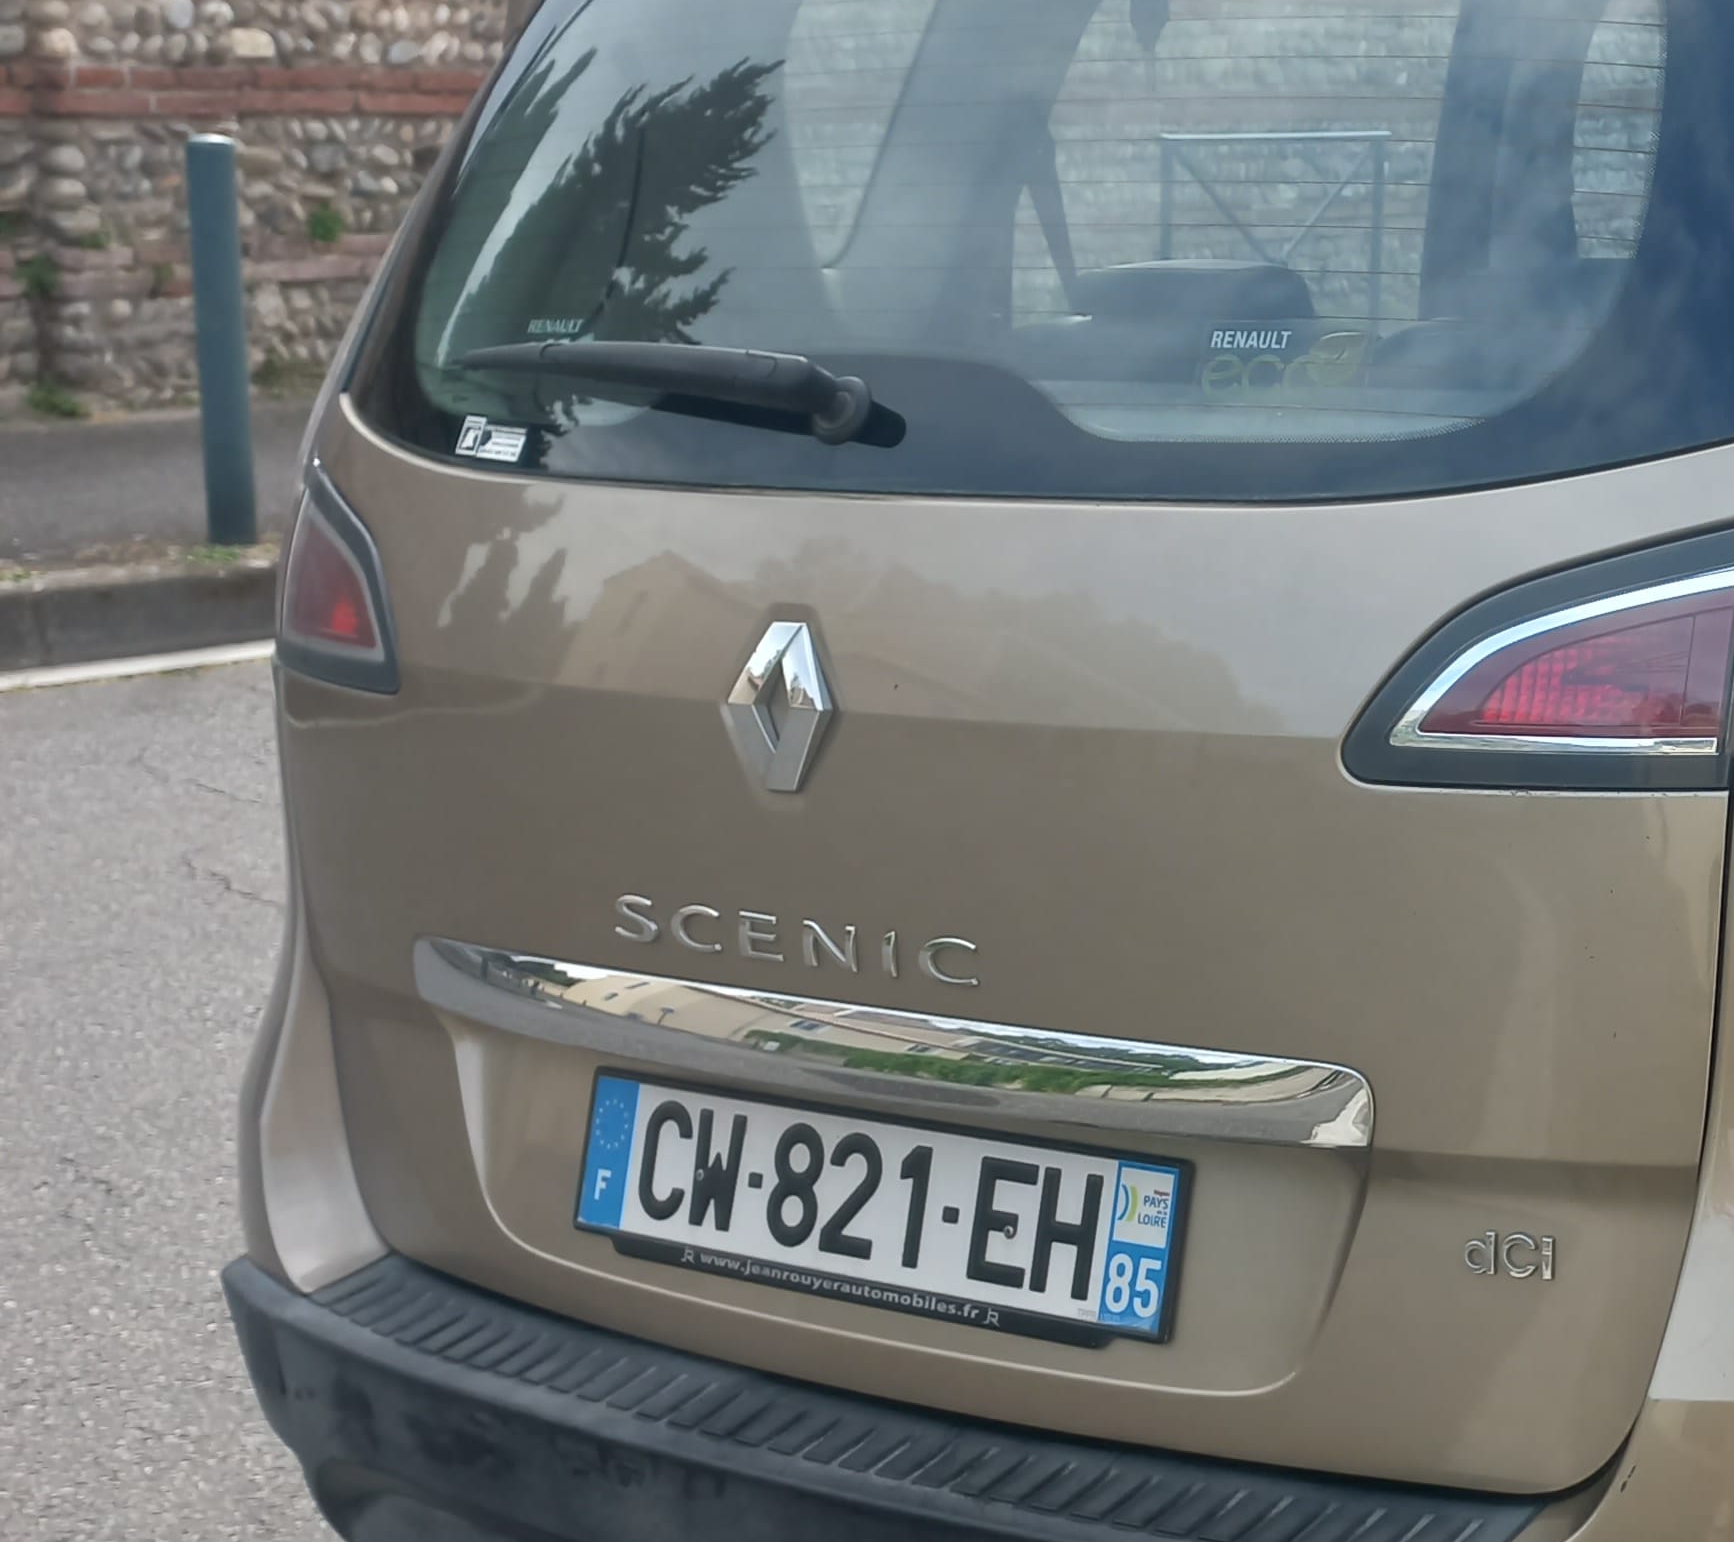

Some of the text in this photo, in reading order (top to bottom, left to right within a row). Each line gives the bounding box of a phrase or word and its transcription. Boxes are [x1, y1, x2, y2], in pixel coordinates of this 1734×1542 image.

[1211, 330, 1292, 349] RENAULT
[614, 893, 980, 988] SCENIC
[594, 1168, 612, 1201] F
[638, 1100, 1104, 1301] CW-821-EH
[1143, 1195, 1169, 1210] PAYS
[1137, 1212, 1167, 1229] LOIRE
[1464, 1230, 1554, 1280] dCi
[700, 1253, 979, 1320] www.jeanrouyerautomobiles.fr
[1104, 1253, 1162, 1318] 85
